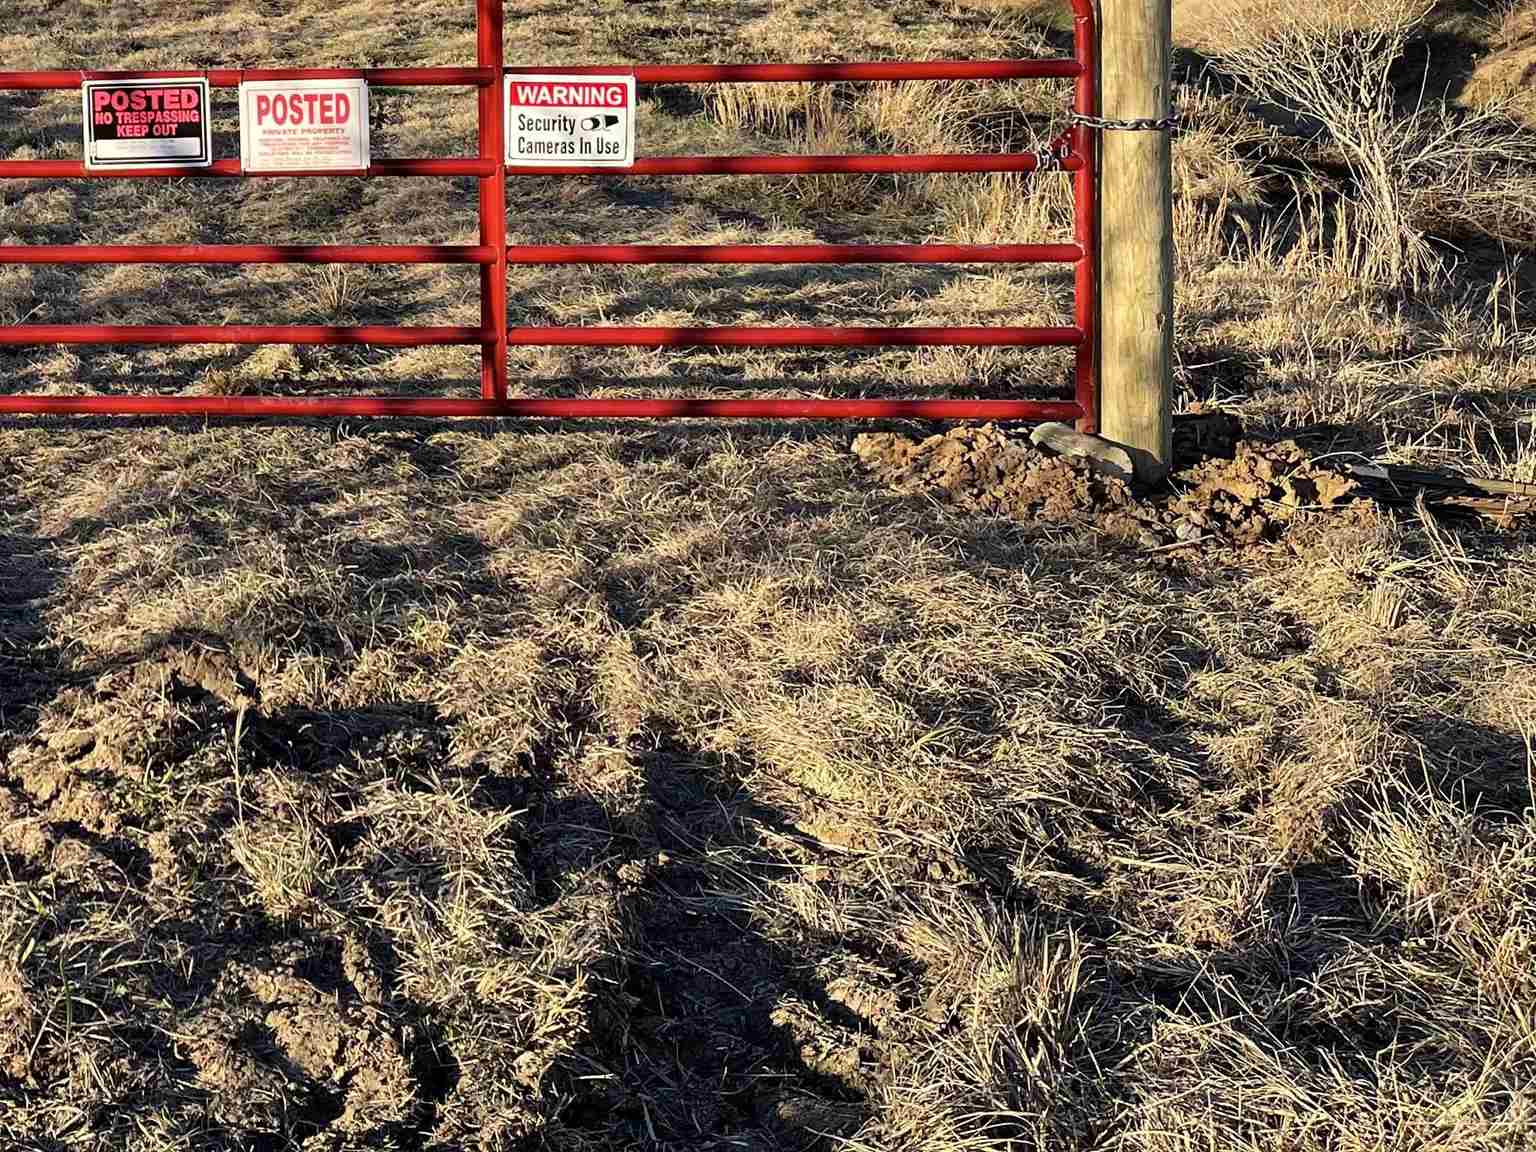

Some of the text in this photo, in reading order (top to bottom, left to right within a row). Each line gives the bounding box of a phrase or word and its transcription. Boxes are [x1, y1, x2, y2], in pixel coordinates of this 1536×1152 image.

[94, 89, 199, 111] POSTED
[516, 85, 622, 105] WARNING
[95, 110, 200, 125] NO TRESPASSING
[256, 93, 350, 126] POSTED
[117, 123, 178, 137] KEEP OUT
[518, 113, 576, 135] Security
[518, 136, 620, 154] Cameras In Use
